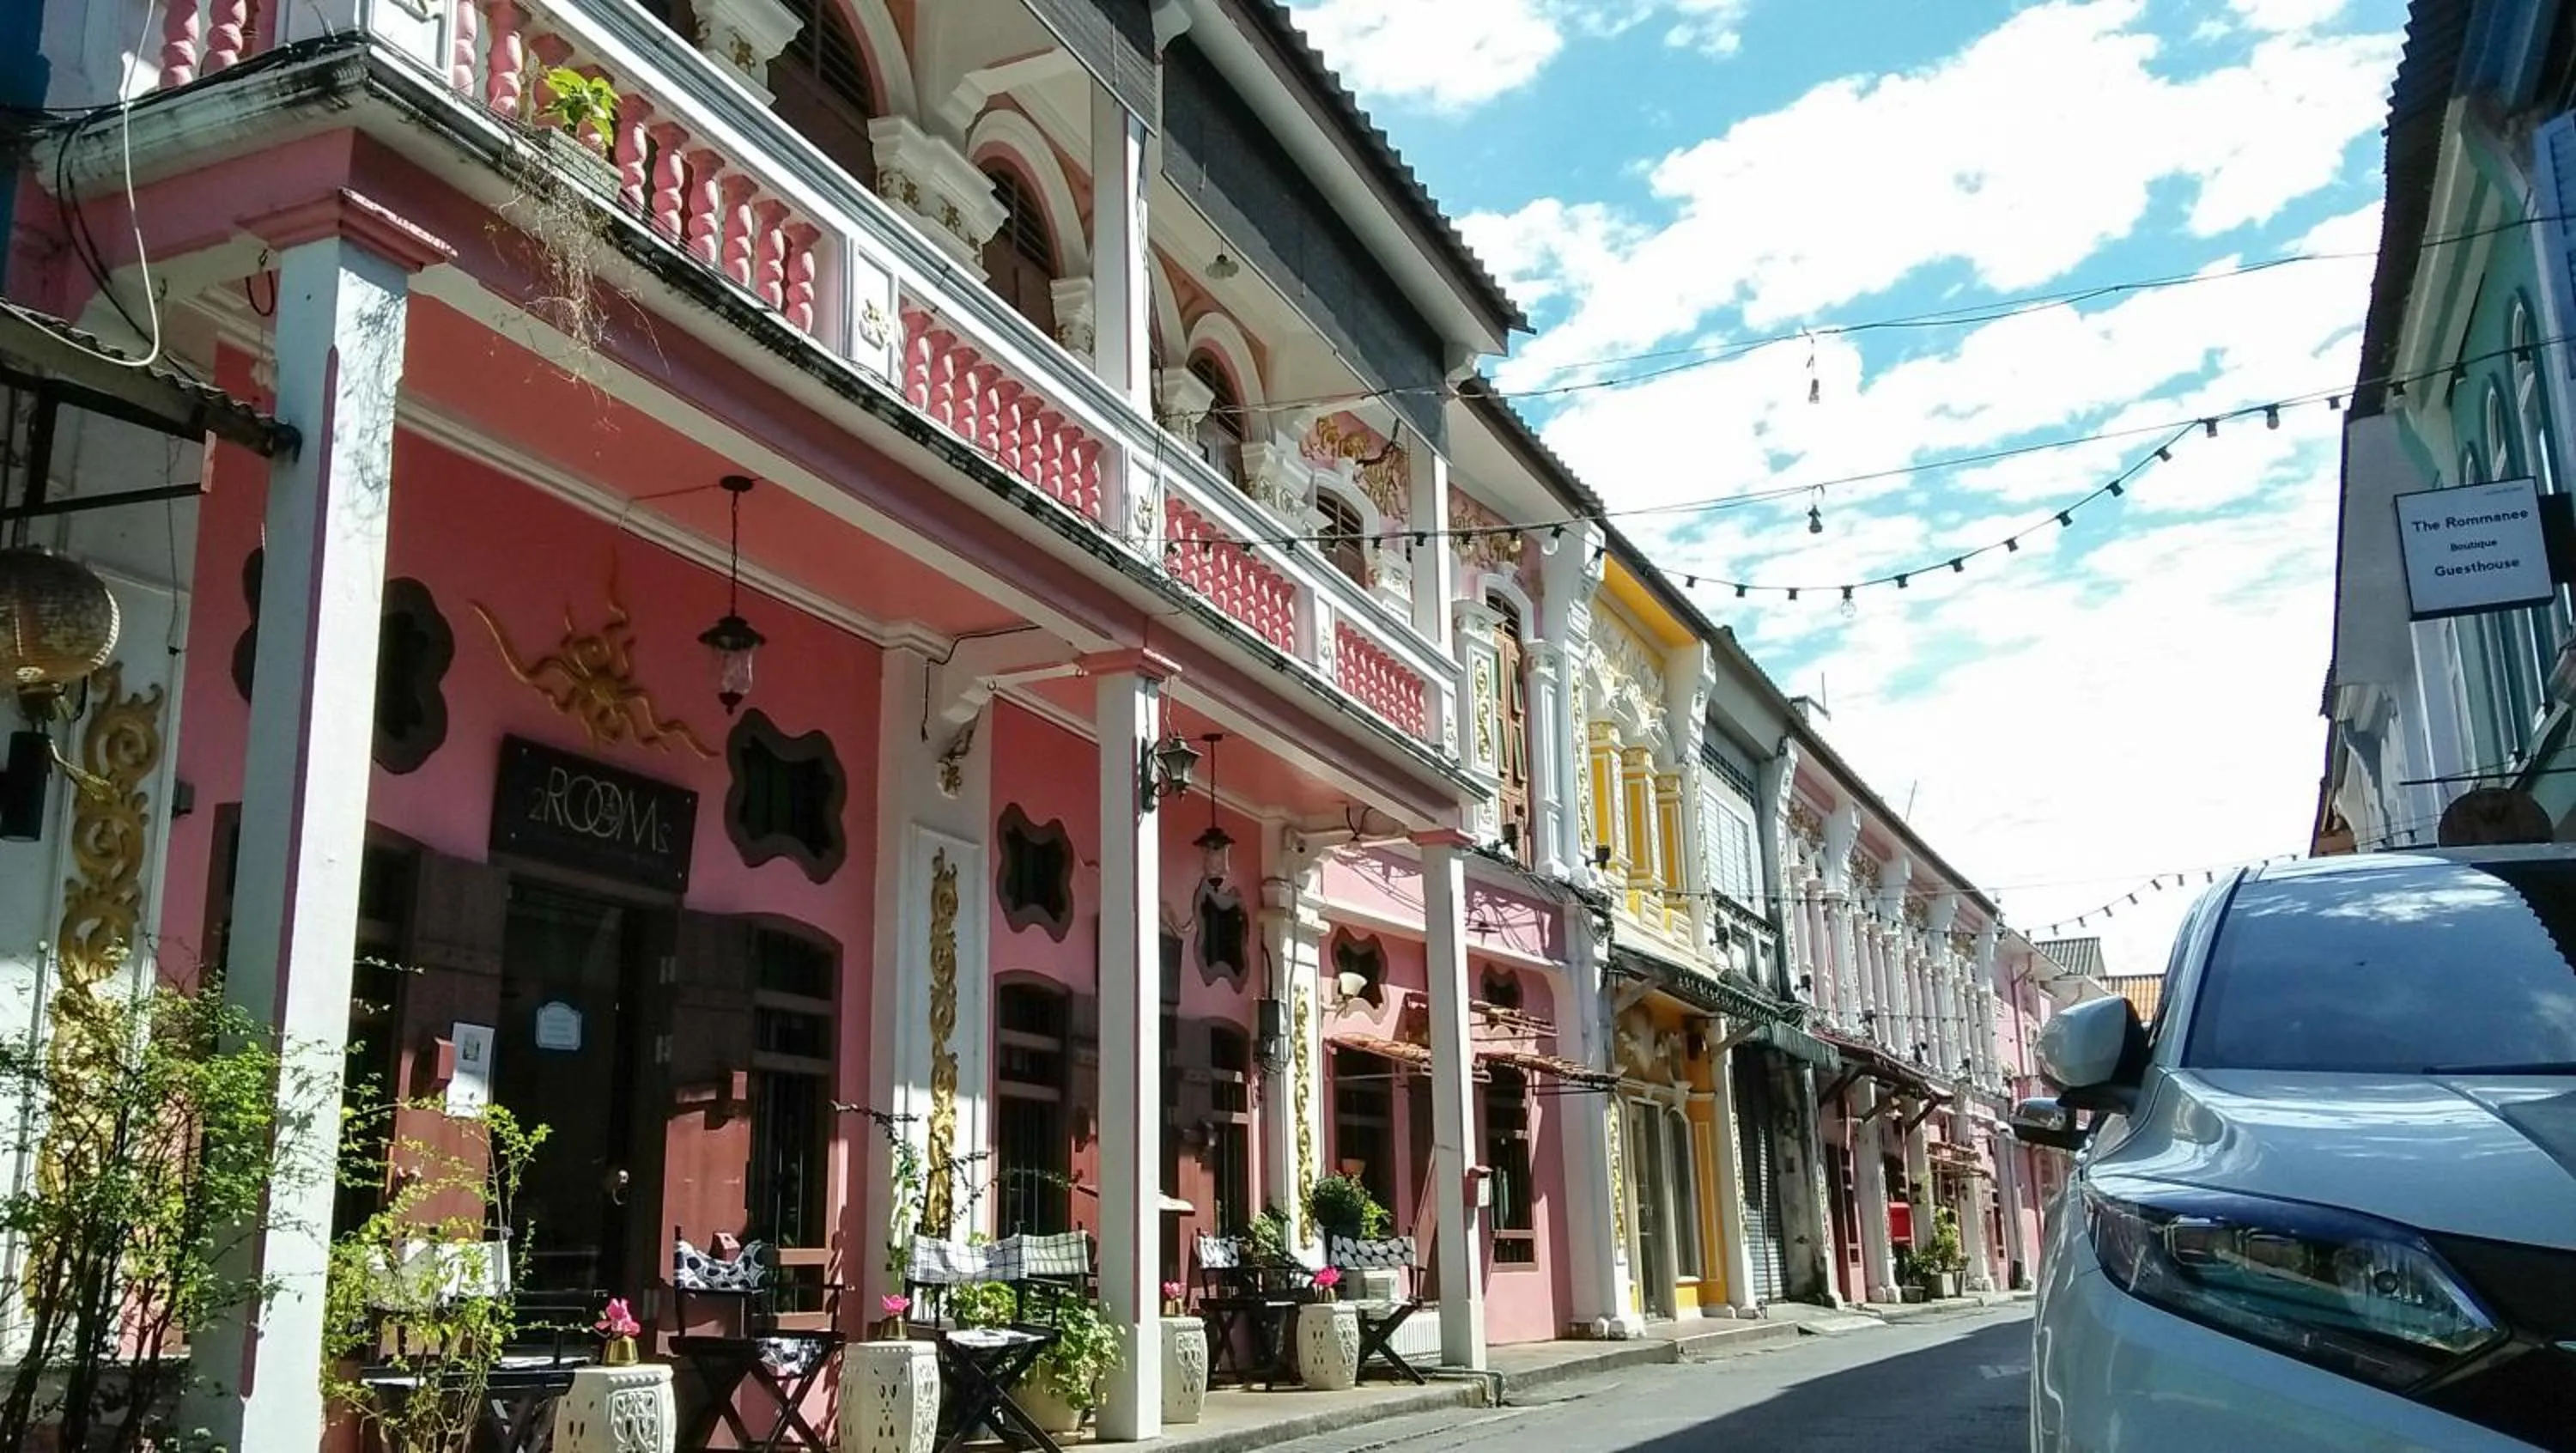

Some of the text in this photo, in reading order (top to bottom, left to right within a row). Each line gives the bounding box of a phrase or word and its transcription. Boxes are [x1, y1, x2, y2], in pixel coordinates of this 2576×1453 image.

[2412, 510, 2529, 532] The Rommanee
[2451, 539, 2498, 551] Boutique
[2434, 559, 2520, 576] Guesthouse
